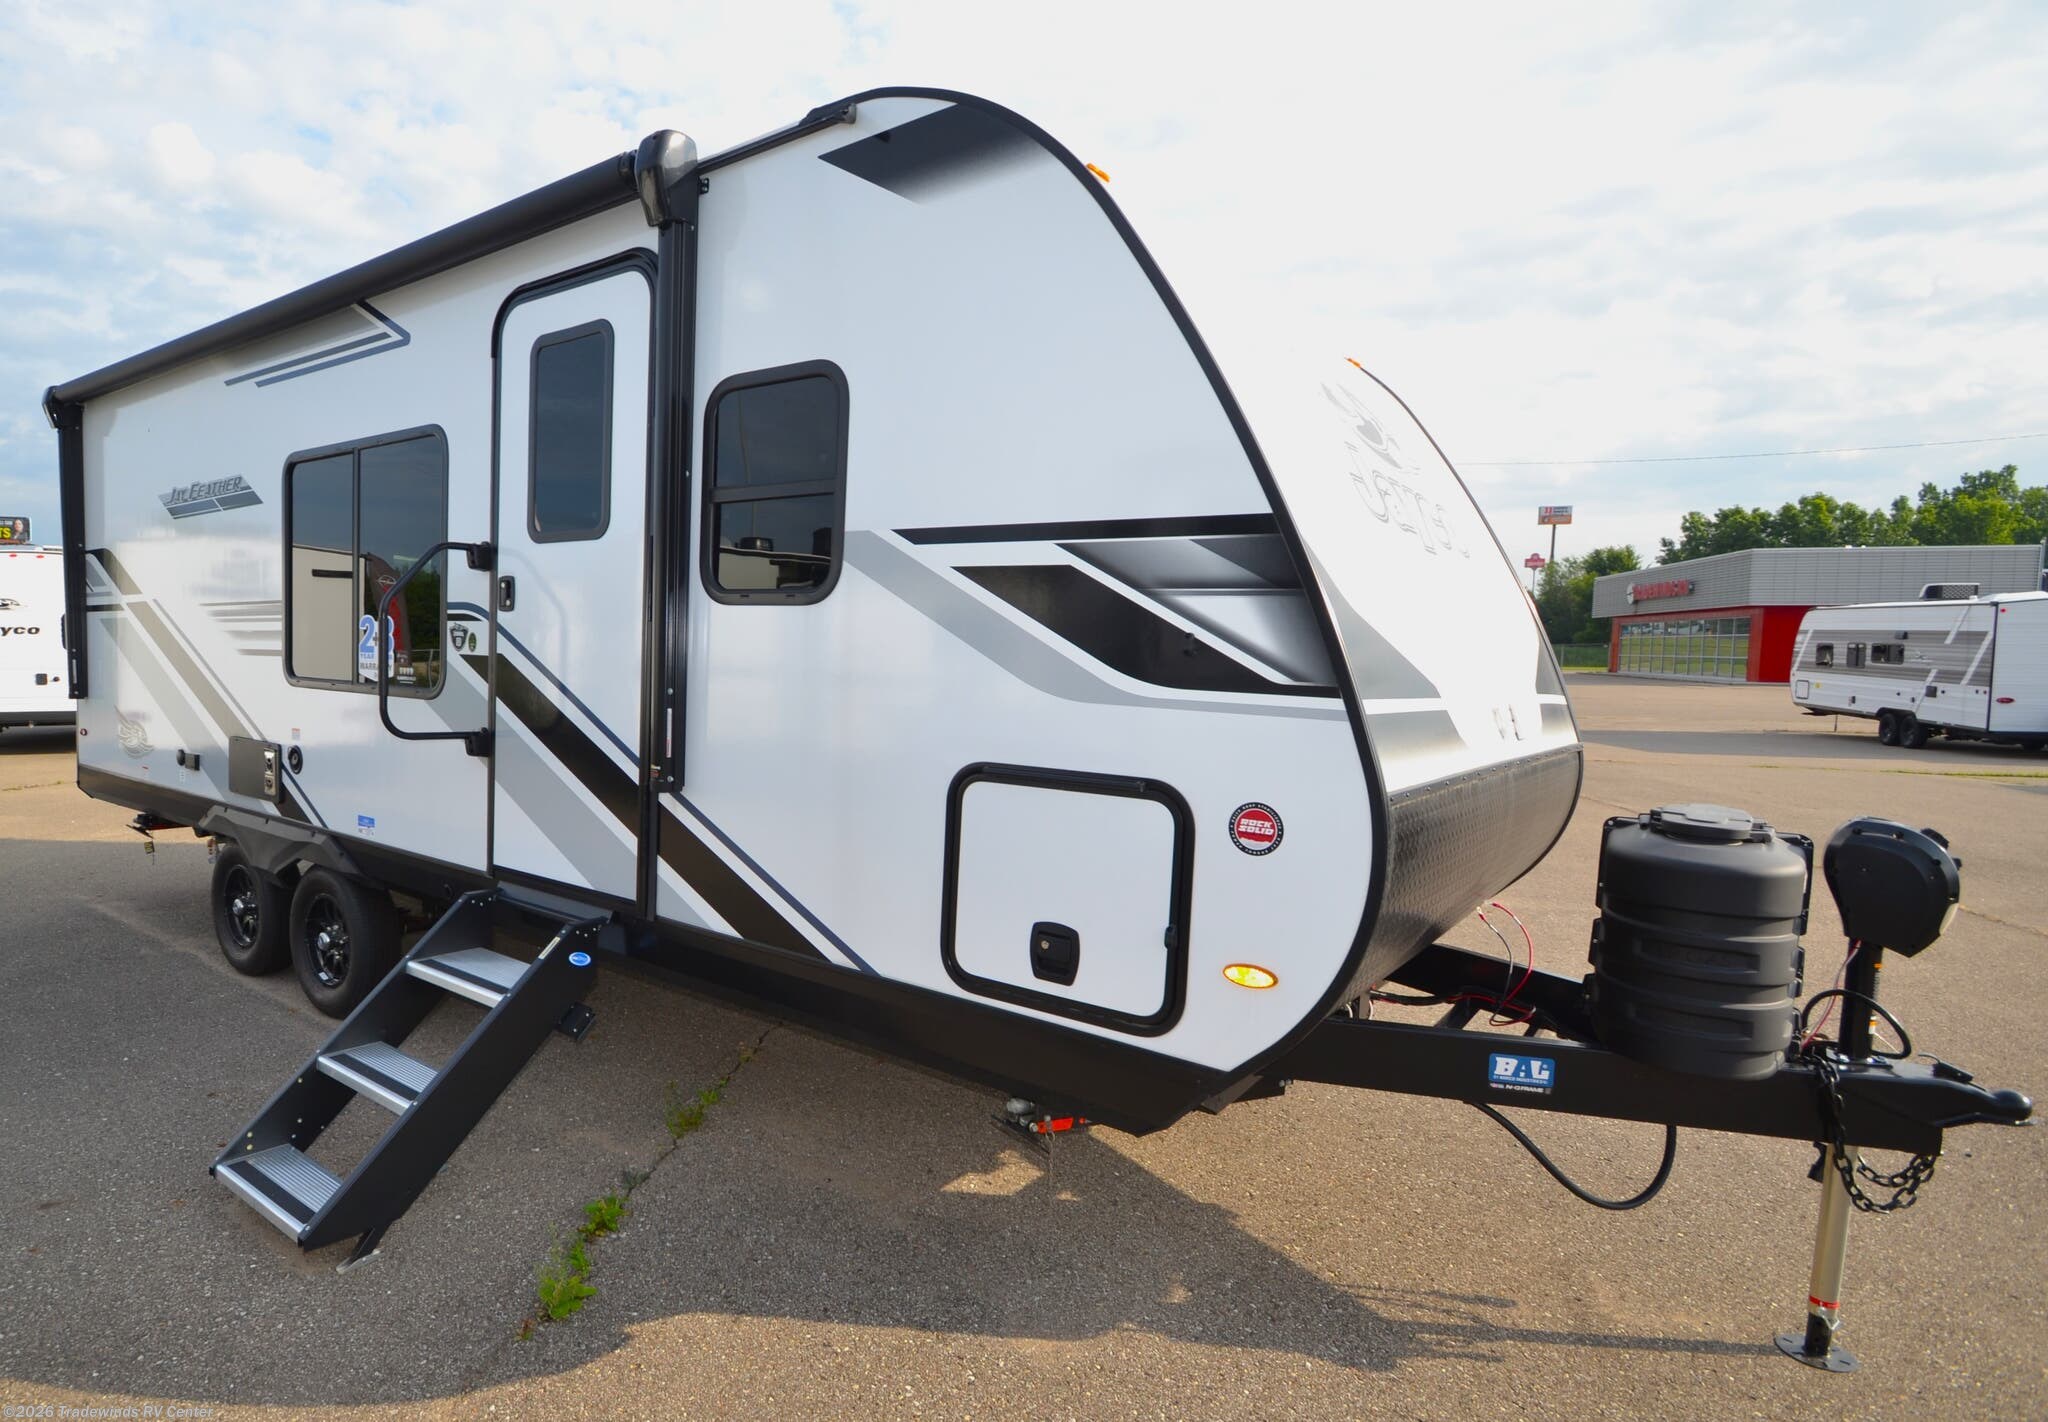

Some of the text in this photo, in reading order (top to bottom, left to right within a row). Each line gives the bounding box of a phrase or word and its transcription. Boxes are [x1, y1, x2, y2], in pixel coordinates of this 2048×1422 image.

[188, 475, 243, 501] FEATHER
[1238, 825, 1274, 835] SOLID
[1240, 818, 1273, 828] ROCK
[1494, 1056, 1550, 1080] BAL
